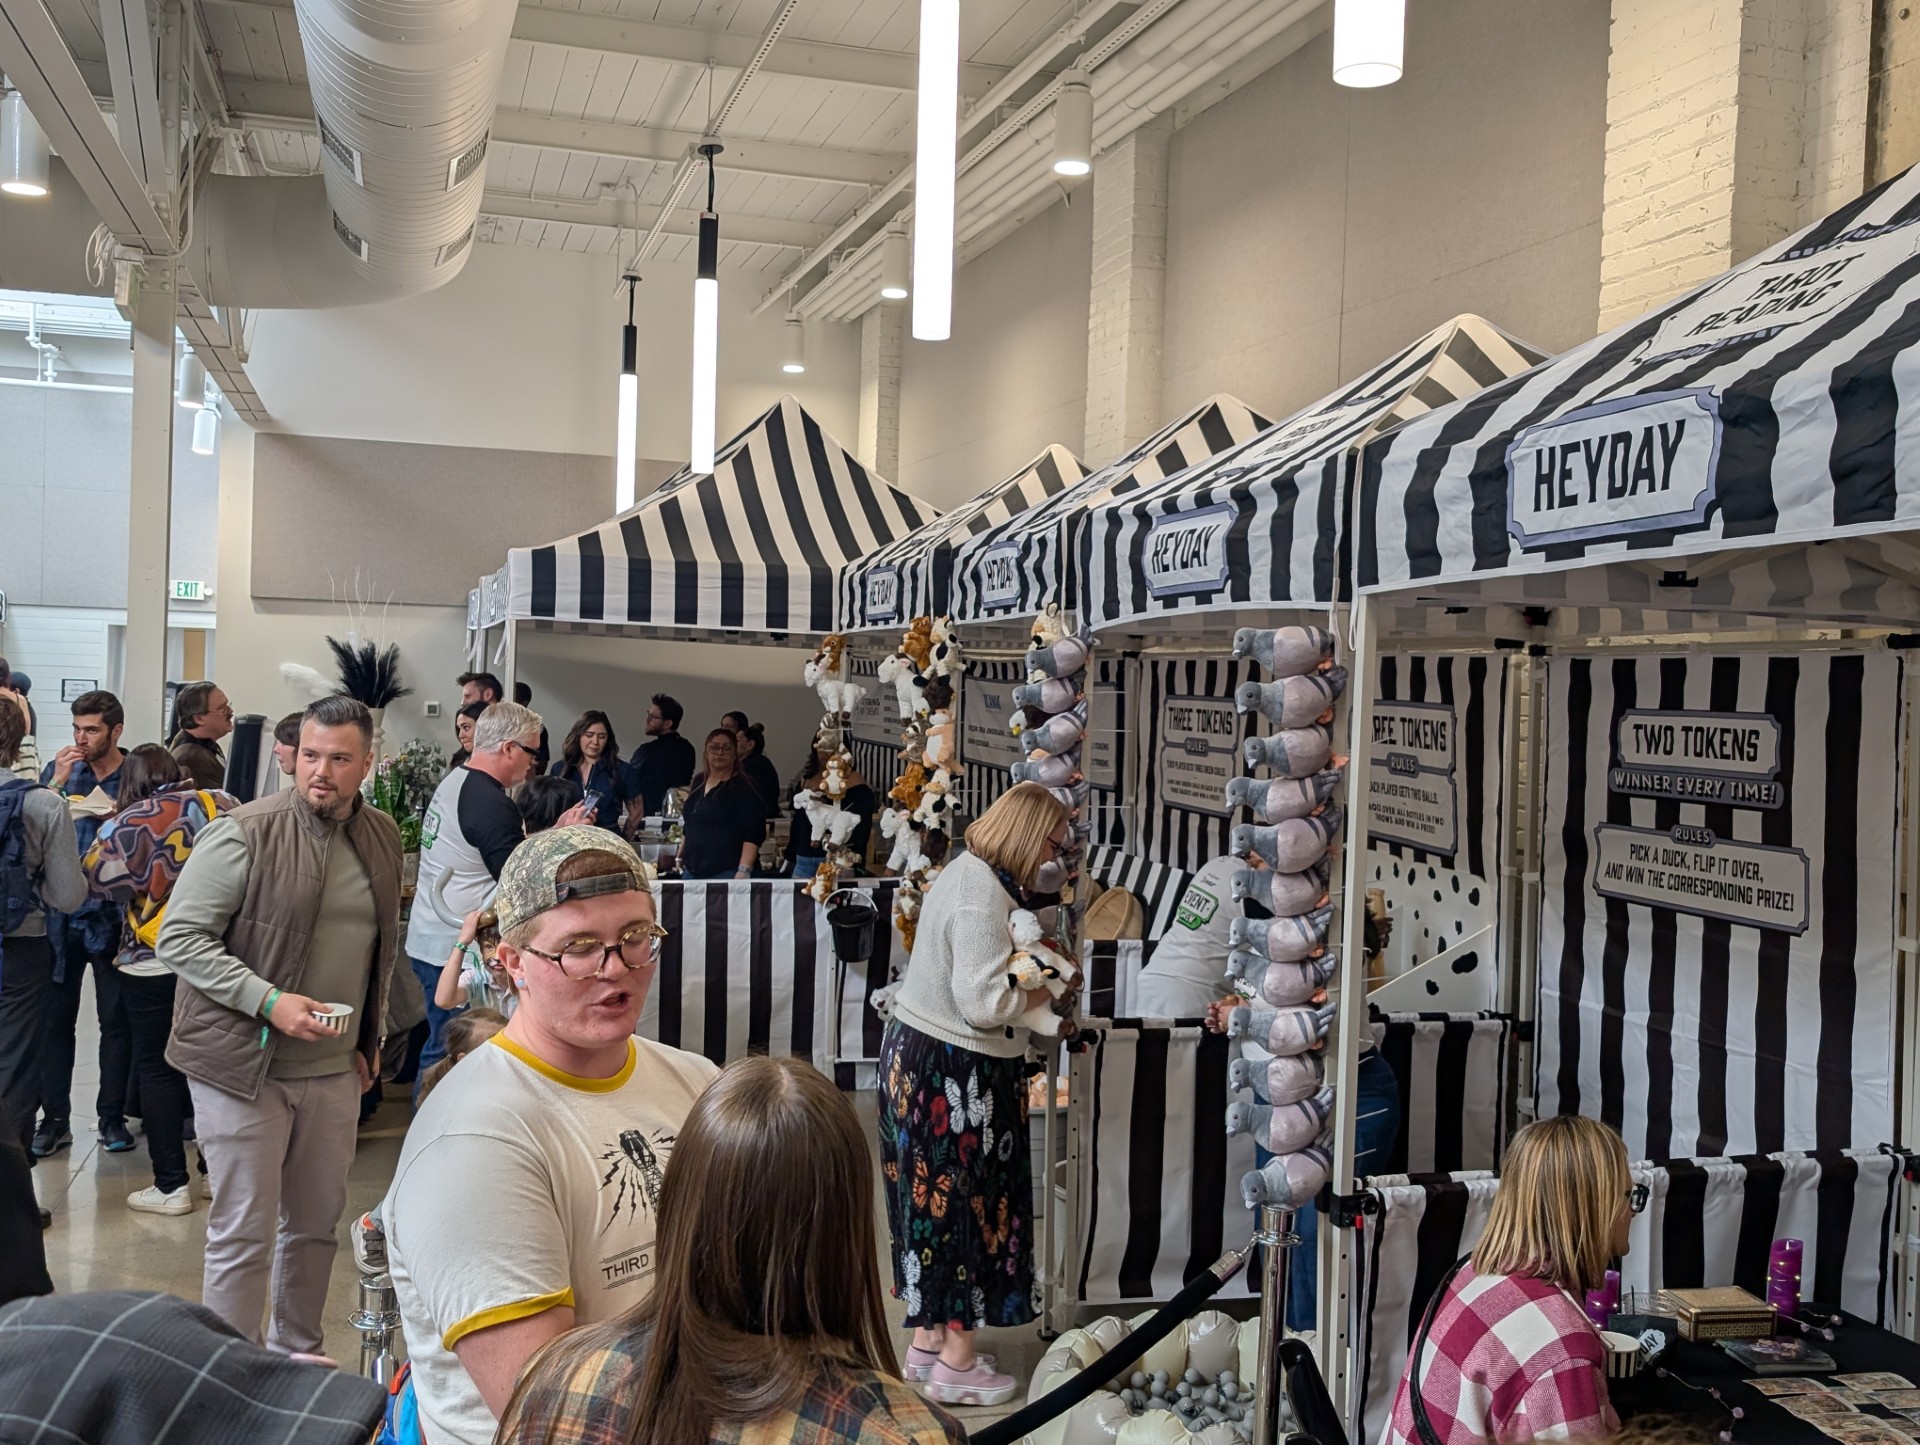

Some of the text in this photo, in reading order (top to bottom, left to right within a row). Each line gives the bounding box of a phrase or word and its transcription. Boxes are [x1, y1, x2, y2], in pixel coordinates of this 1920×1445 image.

[1743, 252, 1866, 303] TAROT
[1682, 280, 1843, 337] READING
[1533, 418, 1686, 512] HEYDAY
[1151, 524, 1221, 574] HEYDAY
[177, 582, 199, 597] EXIT
[1168, 707, 1233, 735] THREE TOKENS
[1372, 715, 1446, 752] REE TOKENS
[1632, 723, 1760, 762] TWO TOKENS
[1391, 756, 1415, 773] RULES
[1399, 785, 1410, 799] GETS
[1614, 770, 1776, 803] WINNER EVERY TIME!
[1406, 810, 1424, 822] BOTTLES
[1432, 815, 1444, 826] TWO
[1675, 828, 1710, 844] RULES
[1630, 843, 1764, 884] PICK A DUCK, FLIP IT OVER,
[1184, 890, 1210, 912] EVENT
[1604, 861, 1794, 912] AND WIN THE CORRESPONDING PRIZE!
[602, 1253, 649, 1280] THIRD
